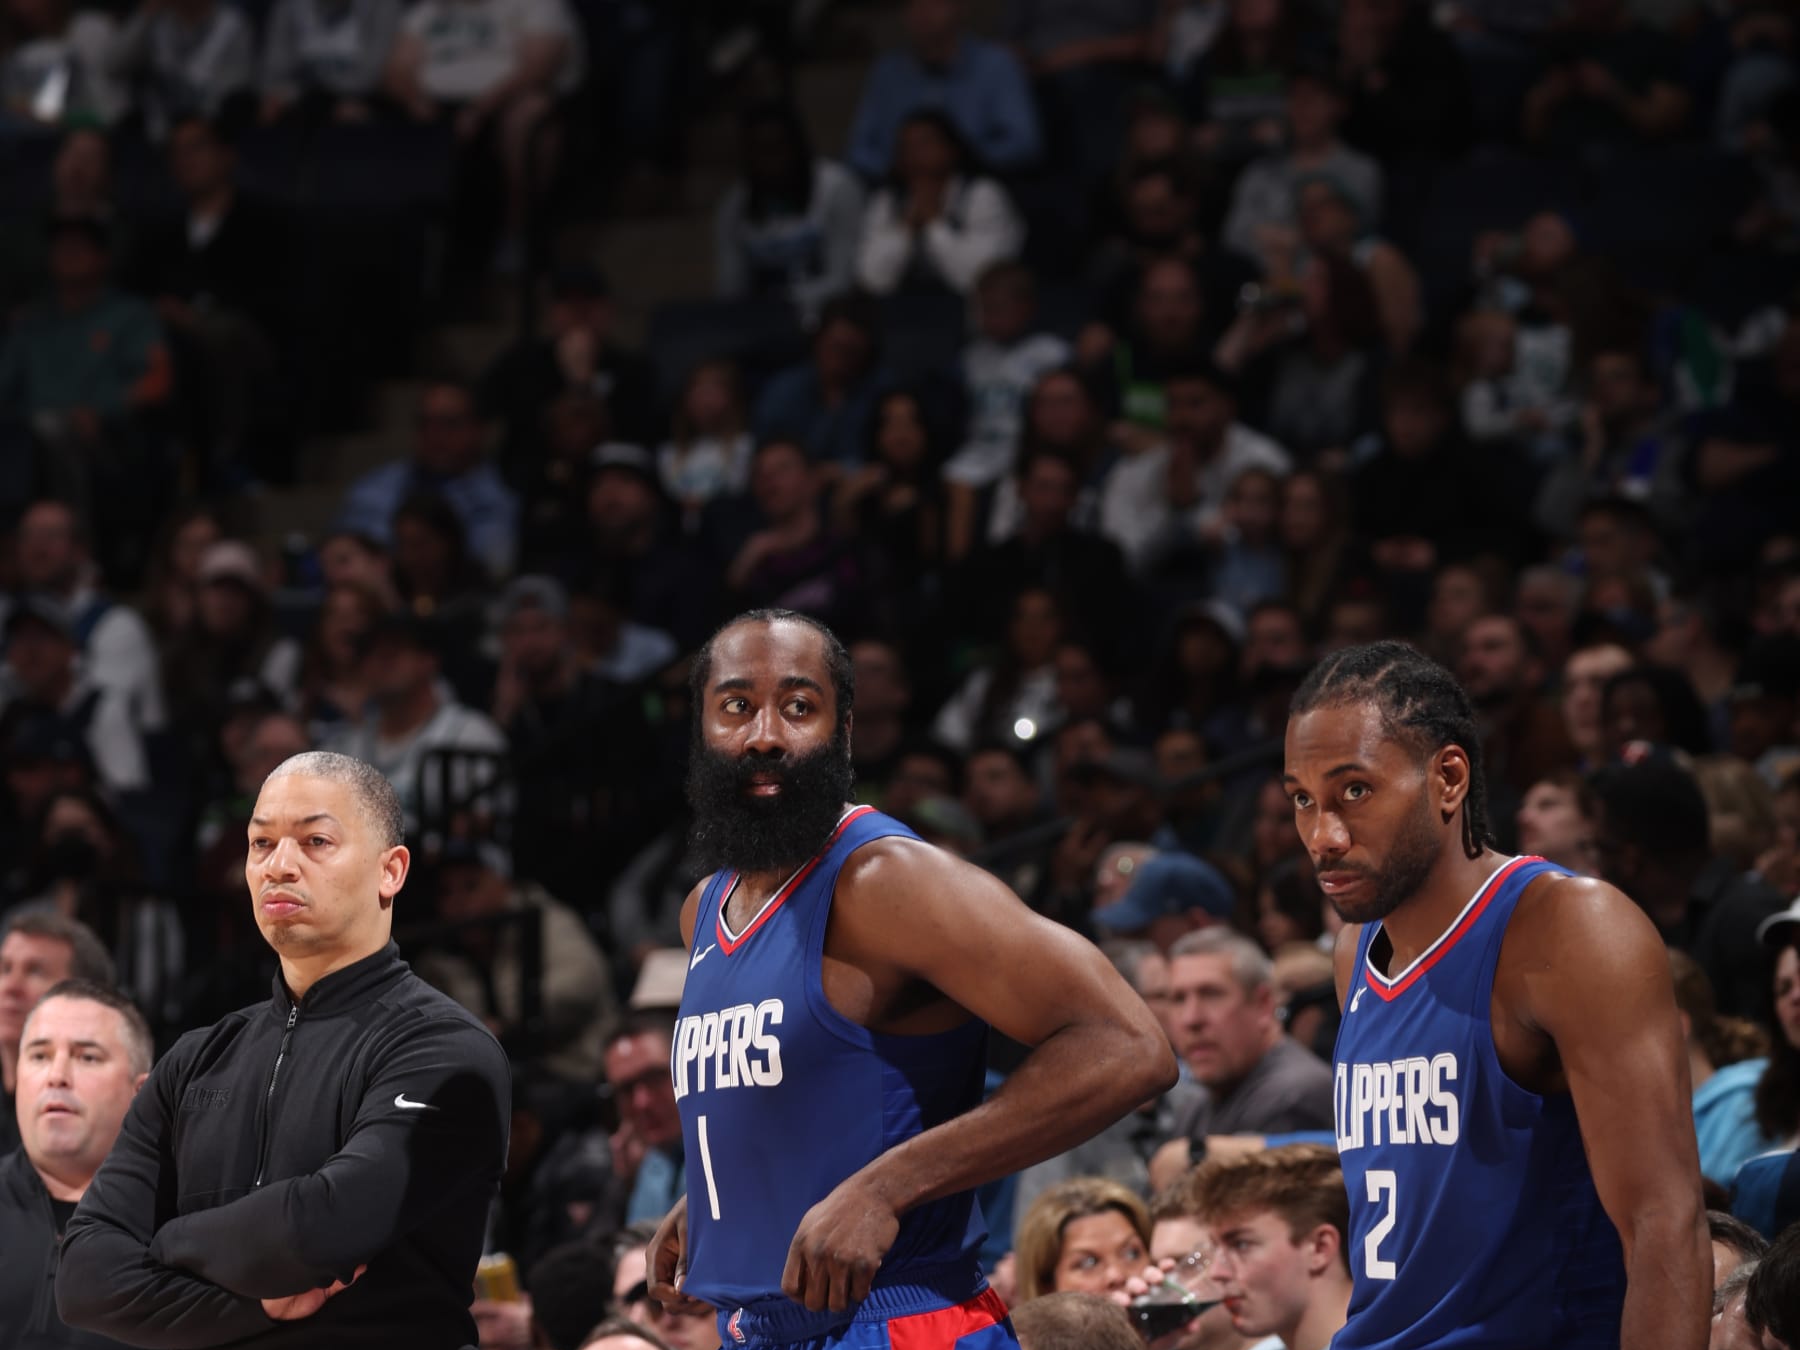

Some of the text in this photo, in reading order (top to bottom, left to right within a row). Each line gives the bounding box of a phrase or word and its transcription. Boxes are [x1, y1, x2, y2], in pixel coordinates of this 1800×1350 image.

[670, 998, 784, 1104] LIPPERS
[1334, 1052, 1460, 1155] CLIPPERS
[697, 1115, 721, 1221] 1
[1364, 1169, 1398, 1281] 2
